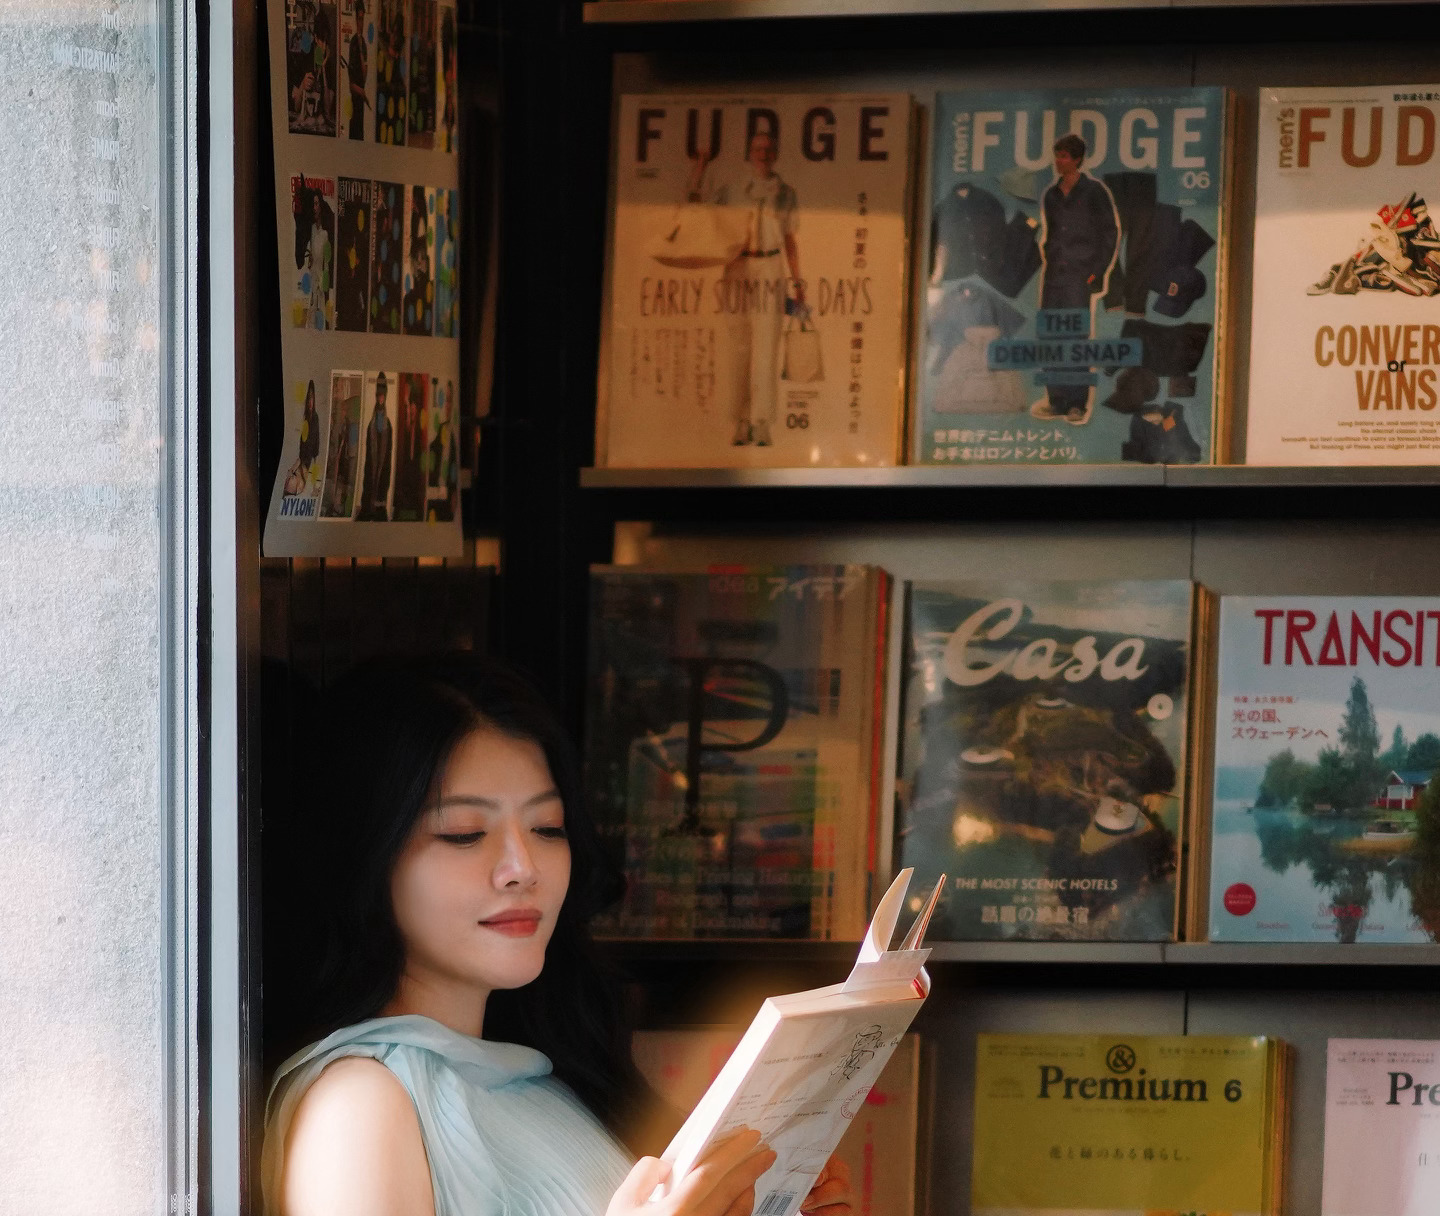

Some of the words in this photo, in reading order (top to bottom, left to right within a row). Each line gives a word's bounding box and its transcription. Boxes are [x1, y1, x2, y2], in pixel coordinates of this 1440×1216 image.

[634, 106, 890, 163] FUDGE
[952, 111, 971, 172] men's
[971, 107, 1207, 172] FUDGE
[1278, 107, 1296, 169] men's
[1181, 170, 1211, 189] 06
[639, 276, 704, 317] EARLY
[818, 276, 873, 317] DAYS
[1044, 313, 1082, 332] THE
[994, 342, 1063, 364] DENIM
[1070, 343, 1132, 362] SNAP
[1387, 360, 1407, 373] or
[1355, 368, 1438, 412] VANS
[785, 412, 810, 430] 06
[281, 497, 312, 516] NYLON
[942, 598, 1150, 688] Casa
[1232, 708, 1281, 723] 光の国、
[1232, 726, 1329, 740] スウェーデンへ
[955, 877, 978, 891] THE
[980, 877, 1019, 891] MOST
[1021, 877, 1068, 891] SCENIC
[1070, 878, 1119, 891] HOTELS
[1038, 1064, 1208, 1102] Premium
[1223, 1079, 1243, 1103] 6
